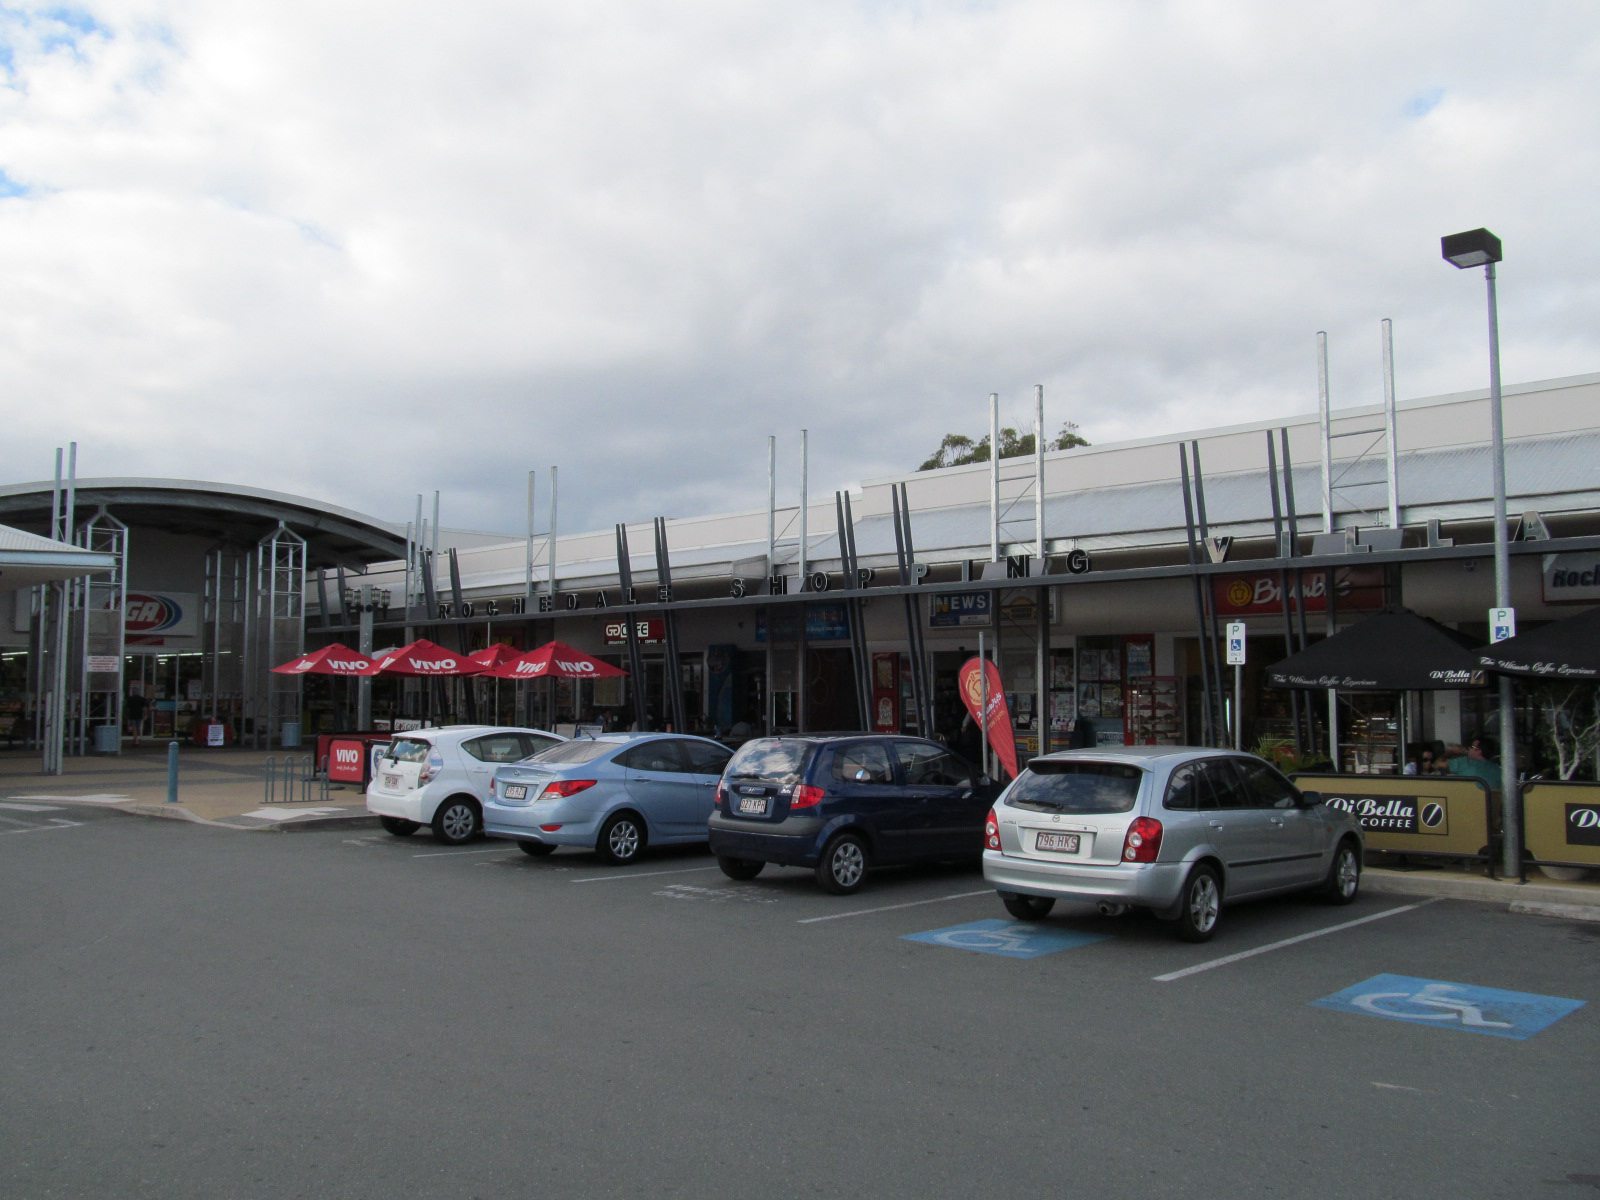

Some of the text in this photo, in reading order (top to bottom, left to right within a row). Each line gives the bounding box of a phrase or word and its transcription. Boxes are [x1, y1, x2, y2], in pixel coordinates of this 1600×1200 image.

[438, 584, 672, 619] ROCHEDALE
[729, 549, 1091, 598] SHOPPING
[936, 595, 987, 613] NEWS
[126, 601, 161, 622] GA
[1498, 611, 1506, 622] P
[621, 623, 648, 637] CFE
[1232, 625, 1239, 635] P
[327, 659, 370, 671] VIVO
[408, 657, 457, 670] VIVO
[515, 661, 547, 673] VIVO
[555, 660, 595, 673] VIVO
[1532, 661, 1556, 675] Coffee
[1557, 664, 1596, 675] Experience
[1444, 670, 1471, 678] Bella
[1319, 675, 1340, 686] Coffee
[1342, 676, 1377, 687] Experience
[336, 749, 359, 763] VIVO
[1356, 798, 1415, 818] Bella
[1360, 817, 1412, 828] COFFEE
[1039, 834, 1077, 849] 796 HKS
